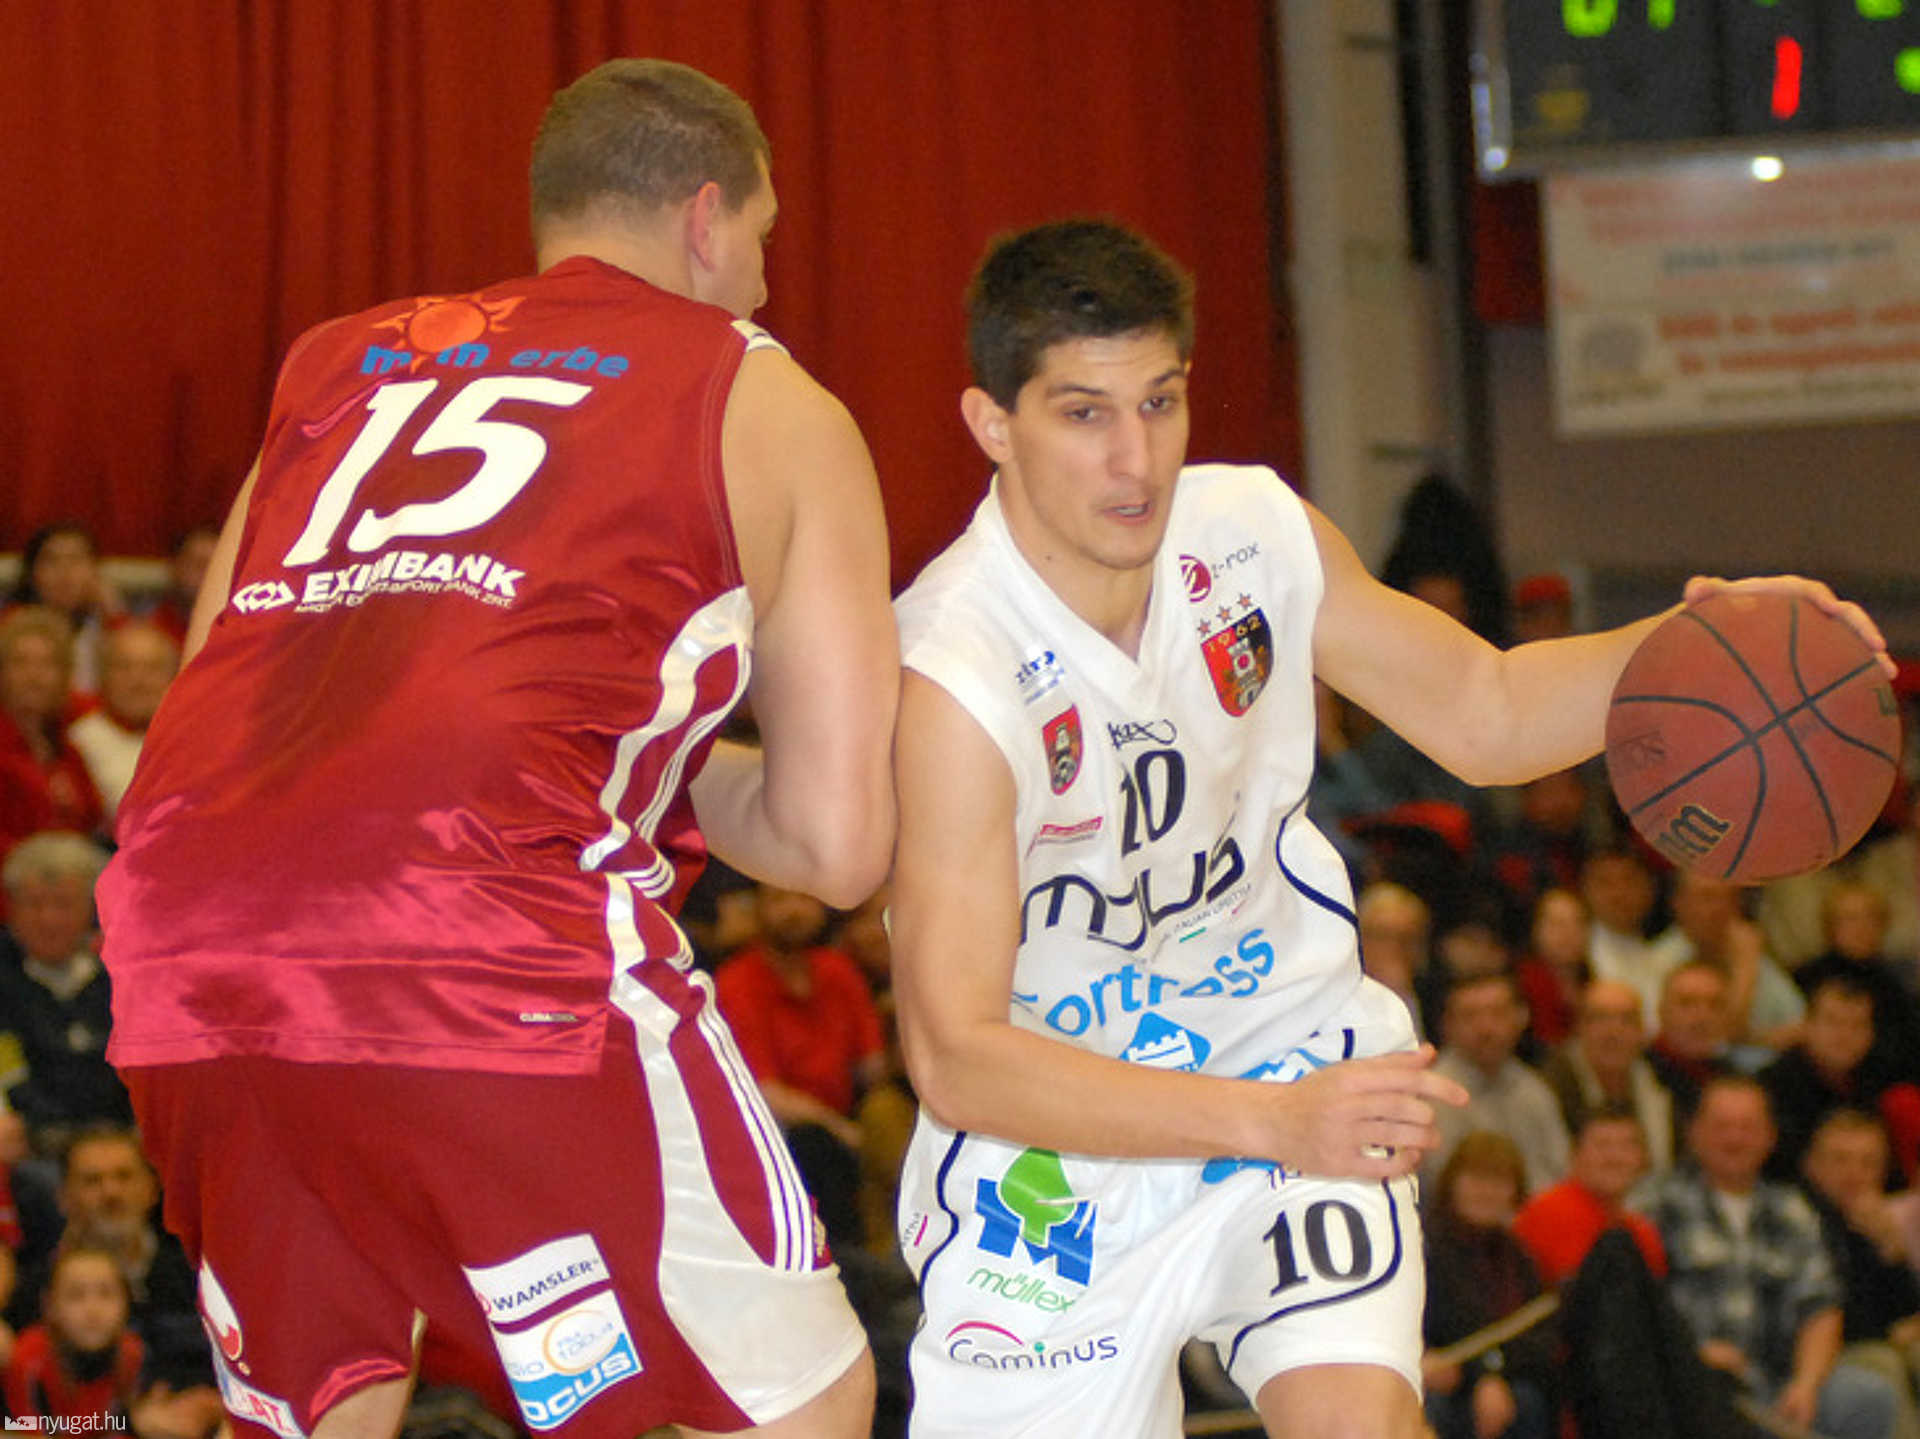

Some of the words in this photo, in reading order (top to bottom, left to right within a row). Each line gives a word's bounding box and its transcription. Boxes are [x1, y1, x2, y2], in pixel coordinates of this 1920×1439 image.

[1771, 35, 1802, 120] 1
[510, 346, 629, 378] erbe
[282, 376, 594, 567] 15
[301, 550, 526, 603] EXIMBANK
[1118, 748, 1187, 859] 10
[1262, 1199, 1373, 1297] 10
[492, 1259, 593, 1311] WAMSLER
[967, 1267, 1075, 1314] müllex
[949, 1335, 1119, 1371] Caminus
